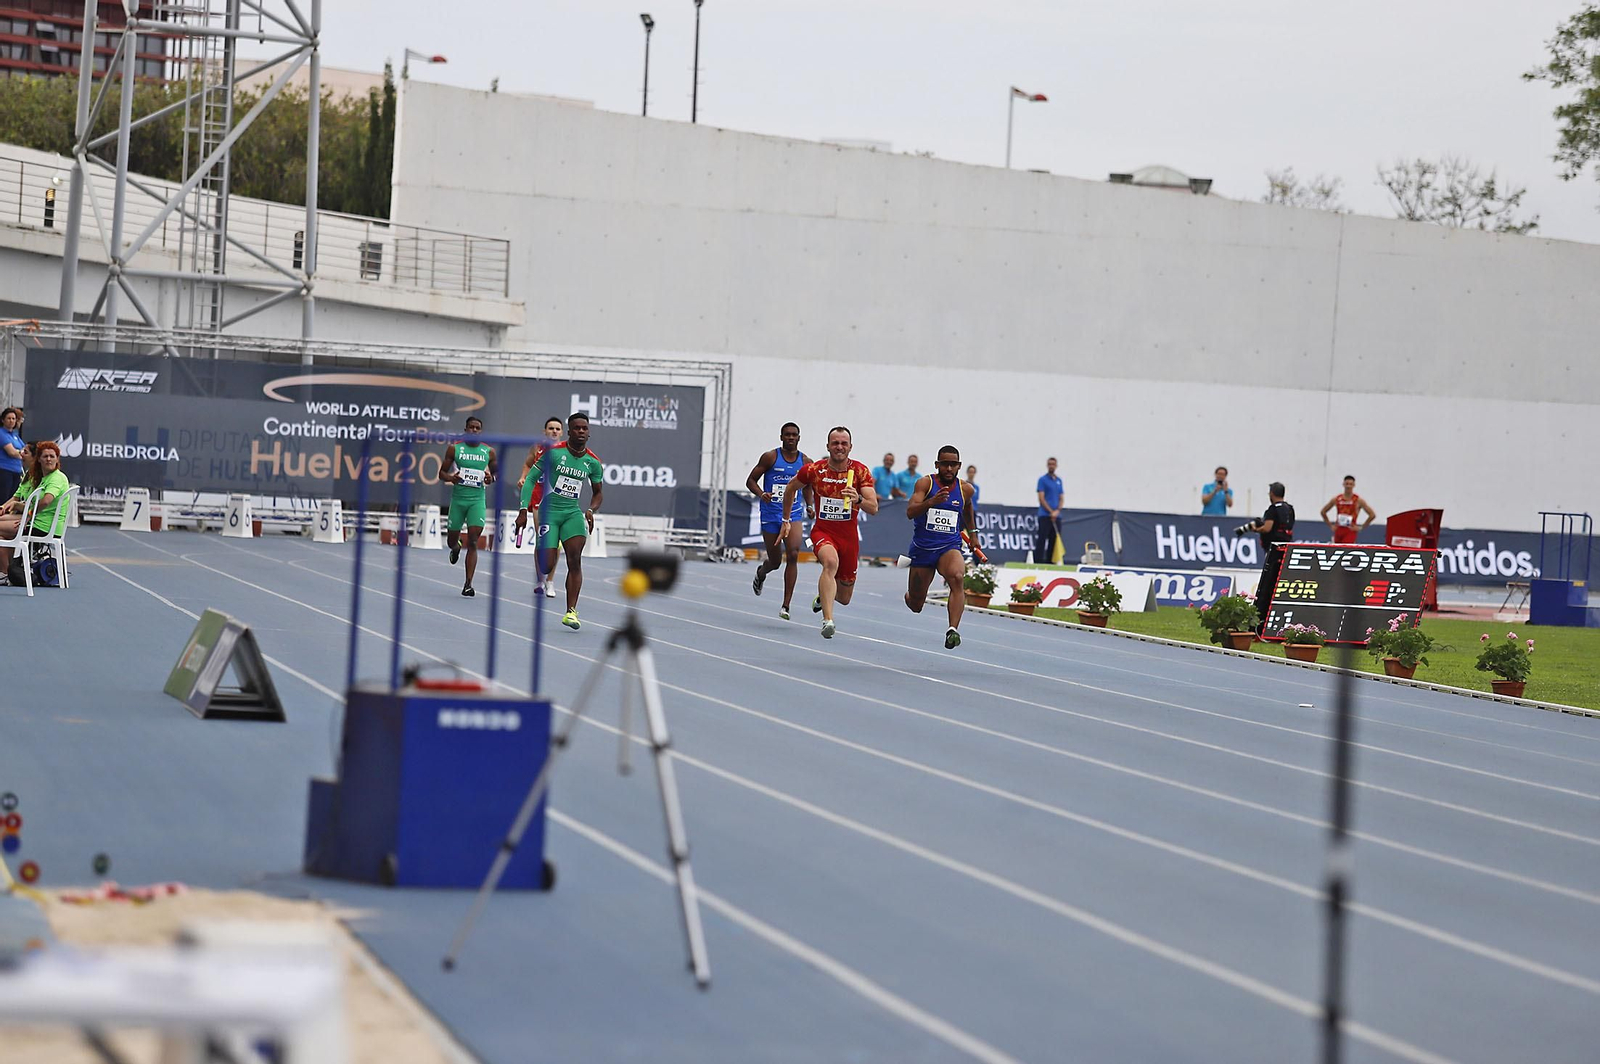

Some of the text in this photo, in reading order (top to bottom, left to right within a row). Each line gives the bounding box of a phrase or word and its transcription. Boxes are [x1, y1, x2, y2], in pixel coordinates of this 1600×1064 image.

[95, 369, 158, 385] RFEA
[90, 383, 151, 393] ATLETISMO
[306, 402, 359, 417] WORLD
[602, 407, 677, 421] DE HUELVA
[264, 417, 371, 439] Continental
[86, 443, 180, 461] IBERDROLA
[459, 453, 486, 461] PORTUGAL
[602, 463, 677, 488] oma
[562, 484, 577, 492] POR
[133, 501, 142, 521] 7
[229, 508, 239, 527] 6
[245, 509, 251, 527] 6
[320, 512, 329, 531] 5
[335, 512, 341, 531] 5
[417, 519, 424, 535] 4
[429, 519, 436, 535] 4
[935, 517, 952, 525] COL
[976, 513, 1039, 531] DIPUTACI
[528, 526, 535, 545] 2
[977, 532, 1039, 550] DE HUEL
[1155, 524, 1541, 577] Huelva ntidos.
[1288, 549, 1425, 575] EVORA
[1275, 580, 1318, 599] POR
